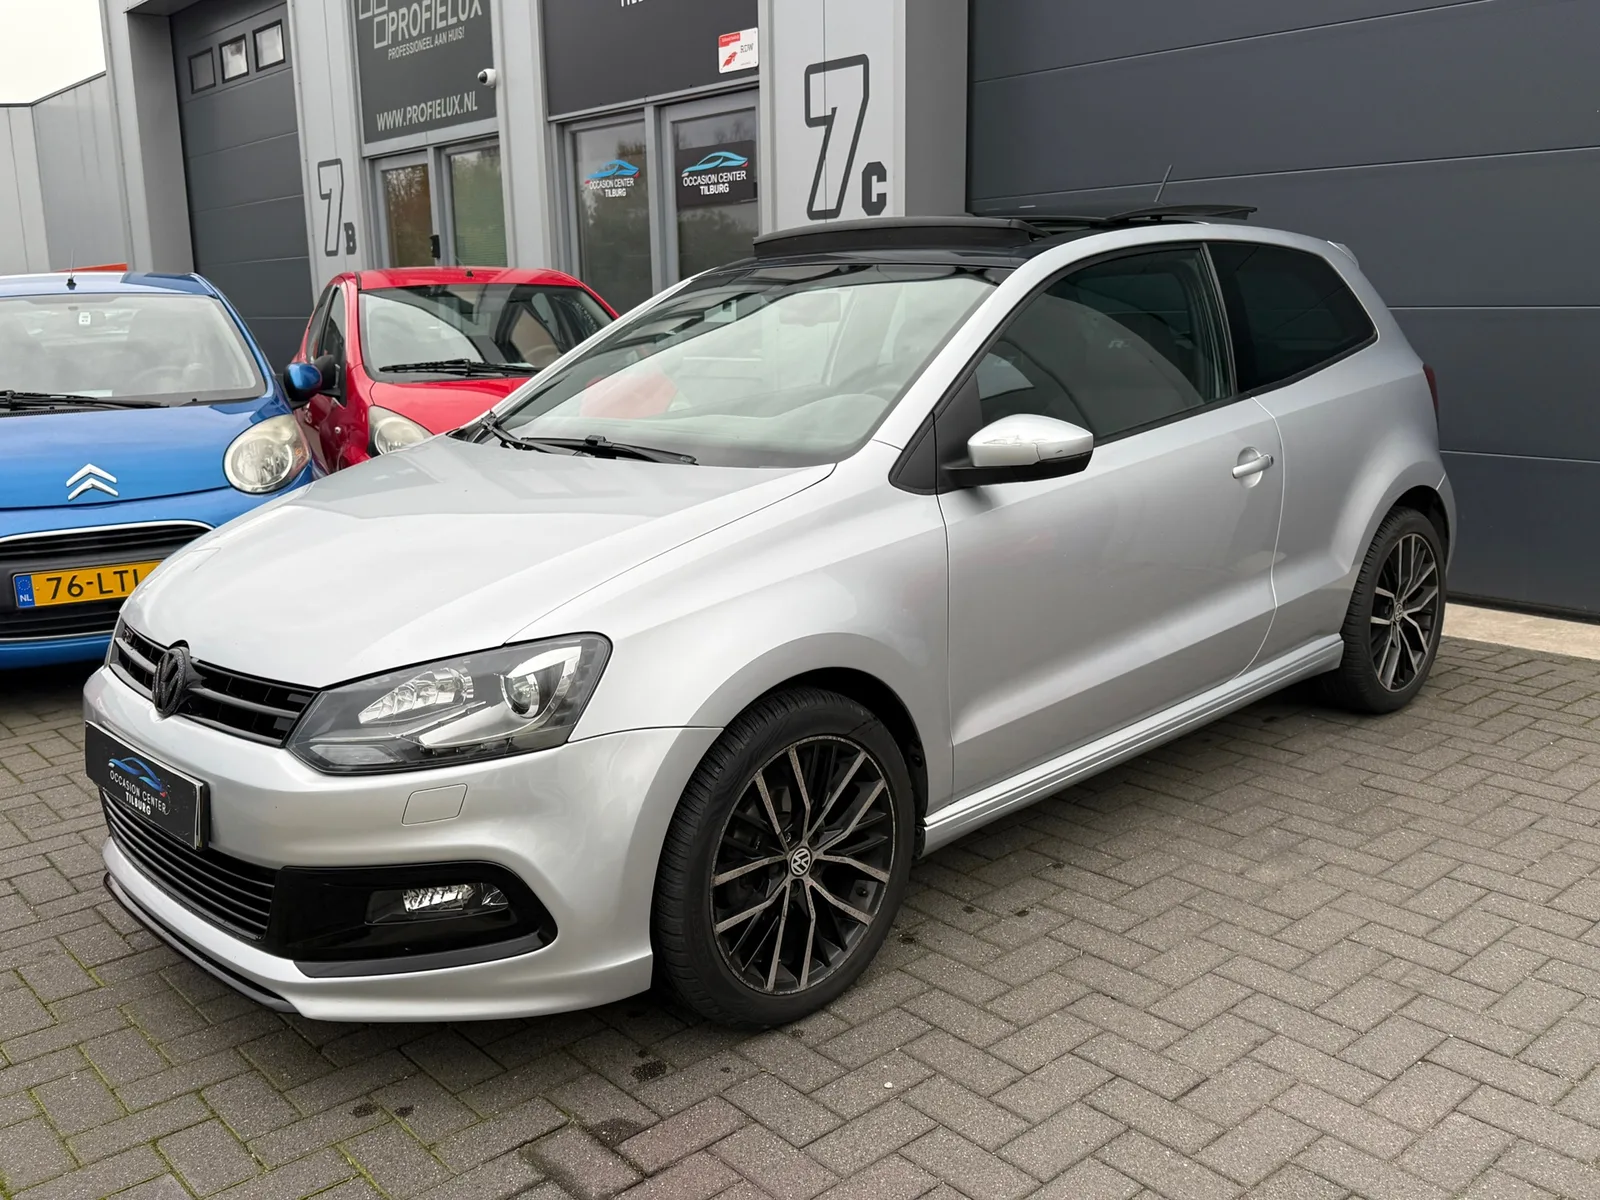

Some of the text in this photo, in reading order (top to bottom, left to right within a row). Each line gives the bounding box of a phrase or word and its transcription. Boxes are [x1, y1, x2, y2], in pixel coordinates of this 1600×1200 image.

[387, 25, 465, 60] PROFESSIONEEL AAN HUIS!
[376, 90, 478, 132] WWW.PROFIELUX.NL
[589, 177, 635, 190] OCCASION CENTER
[682, 170, 747, 187] OCCASION CENTER
[605, 188, 626, 198] TILBURG
[700, 183, 729, 196] TILBURG
[19, 594, 33, 603] NL
[109, 769, 167, 813] OCCASION CENTER
[125, 791, 152, 816] TILBURG
